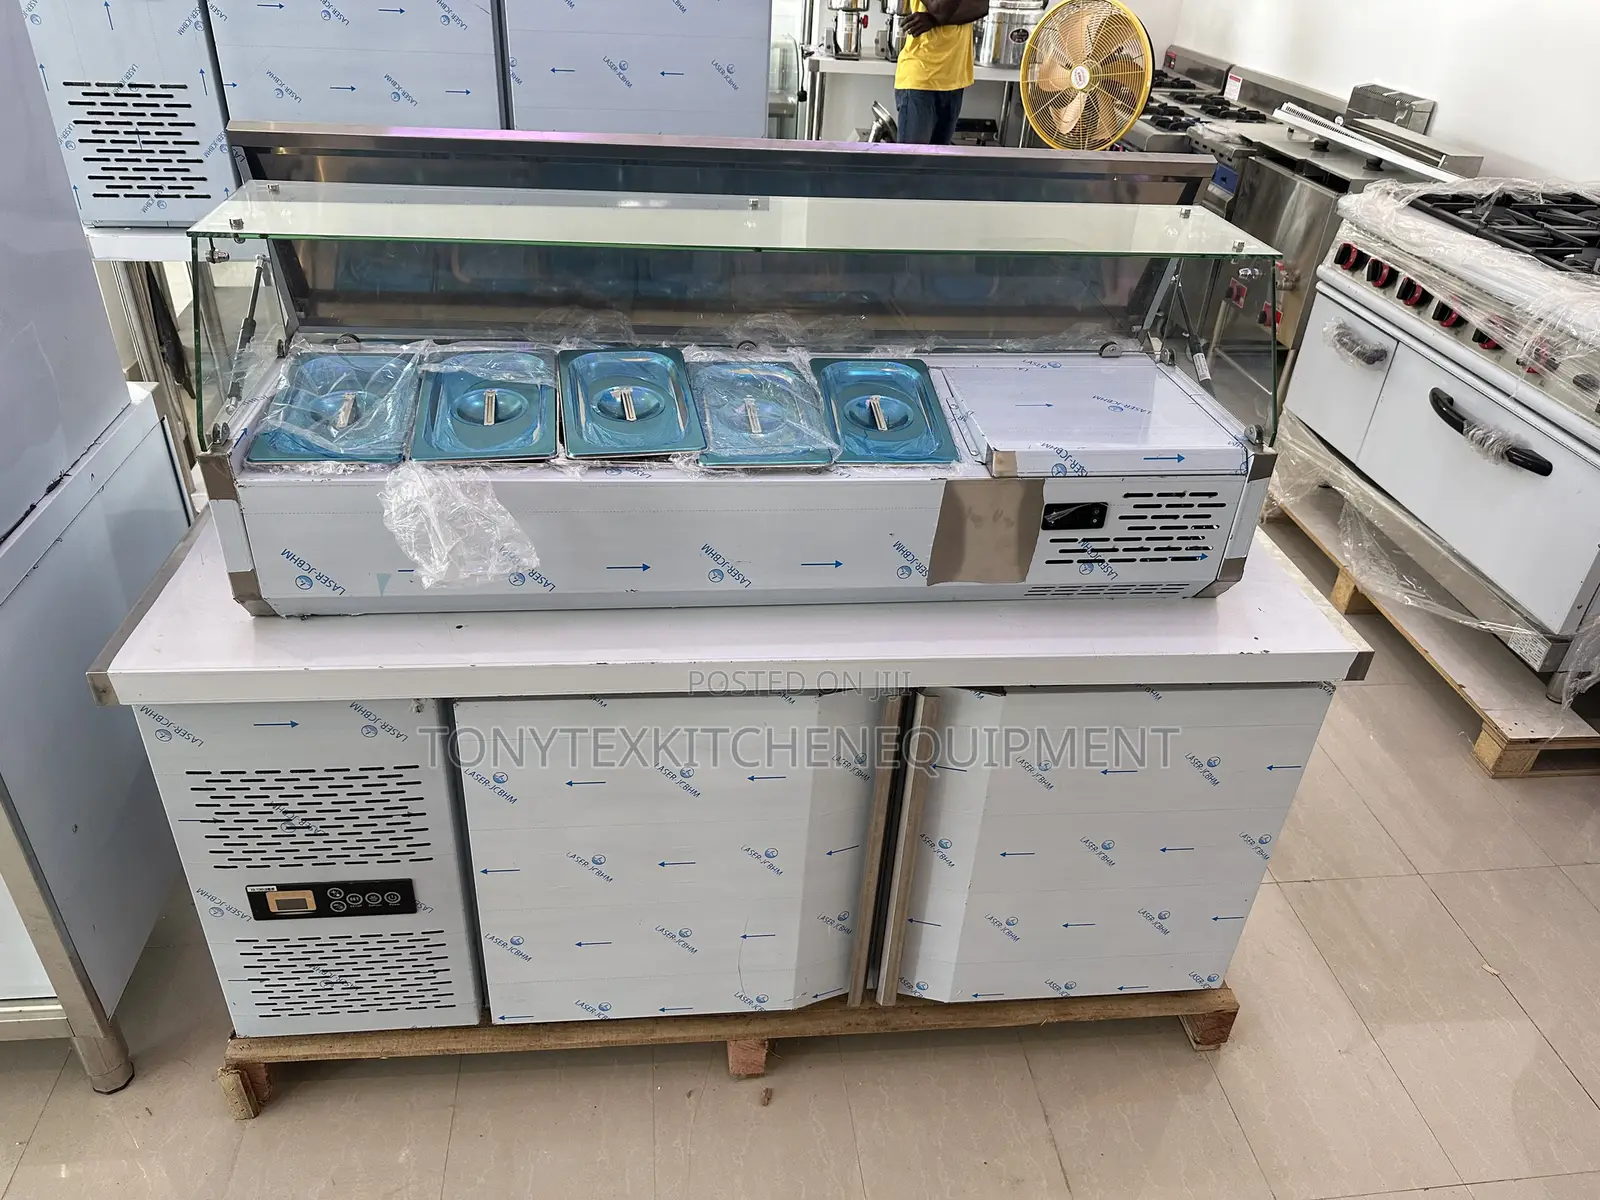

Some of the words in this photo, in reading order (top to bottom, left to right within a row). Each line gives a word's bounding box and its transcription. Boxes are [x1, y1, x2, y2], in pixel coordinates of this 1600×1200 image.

[266, 69, 302, 103] LASER-JCBHM
[602, 55, 633, 89] LASER-JCBHM
[711, 59, 739, 92] LASER-JCBHM
[384, 73, 418, 107] LASER-JCBHM
[1092, 394, 1152, 415] LASER-JCBHM
[280, 548, 346, 596] LASER-JCBHM
[701, 543, 752, 588] LASER-JCBHM
[892, 540, 929, 579] SER-JCBHM
[139, 704, 204, 747] LASER-JCBHM
[350, 701, 409, 743] LASER-JCBHM
[464, 767, 518, 805] LASER-JCBHM
[654, 762, 701, 799] LASER-JCBHM
[1015, 755, 1054, 790] LASER-JCBHM
[1184, 751, 1220, 788] LASER-JCBHM
[566, 850, 614, 884] LASER-JCBHM
[740, 844, 784, 877] LASER-JCBHM
[919, 833, 955, 869] ASER-JCBHM
[1079, 835, 1116, 868] LASER-JCBHM
[196, 887, 252, 922] LASER-JCBHM
[1137, 907, 1171, 936] LASER-JCBHM
[655, 924, 698, 955] LASER-JCBHM
[984, 913, 1021, 943] LASER-JCBHM
[484, 932, 532, 963] LASER-JCBHM
